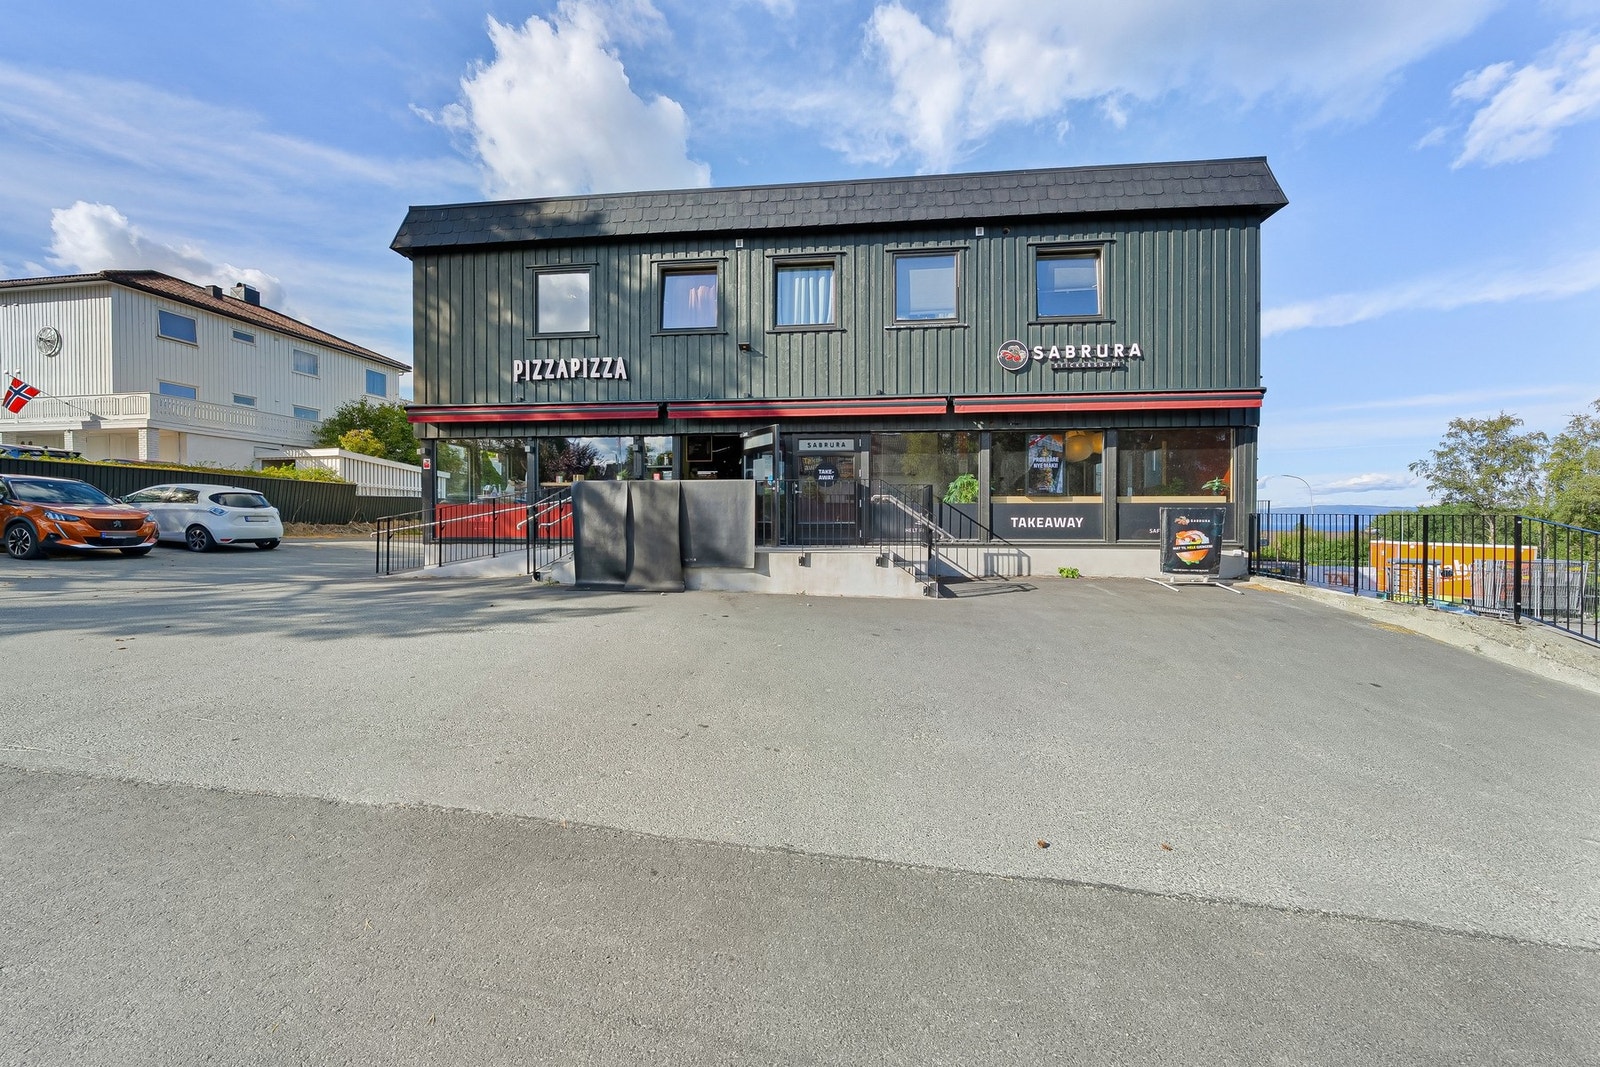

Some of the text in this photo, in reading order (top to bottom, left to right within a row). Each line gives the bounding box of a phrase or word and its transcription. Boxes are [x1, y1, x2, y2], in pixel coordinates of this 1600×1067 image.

[1033, 343, 1141, 360] SABRURA
[513, 356, 628, 382] PIZZAPIZZA
[1010, 517, 1084, 528] TAKEAWAY
